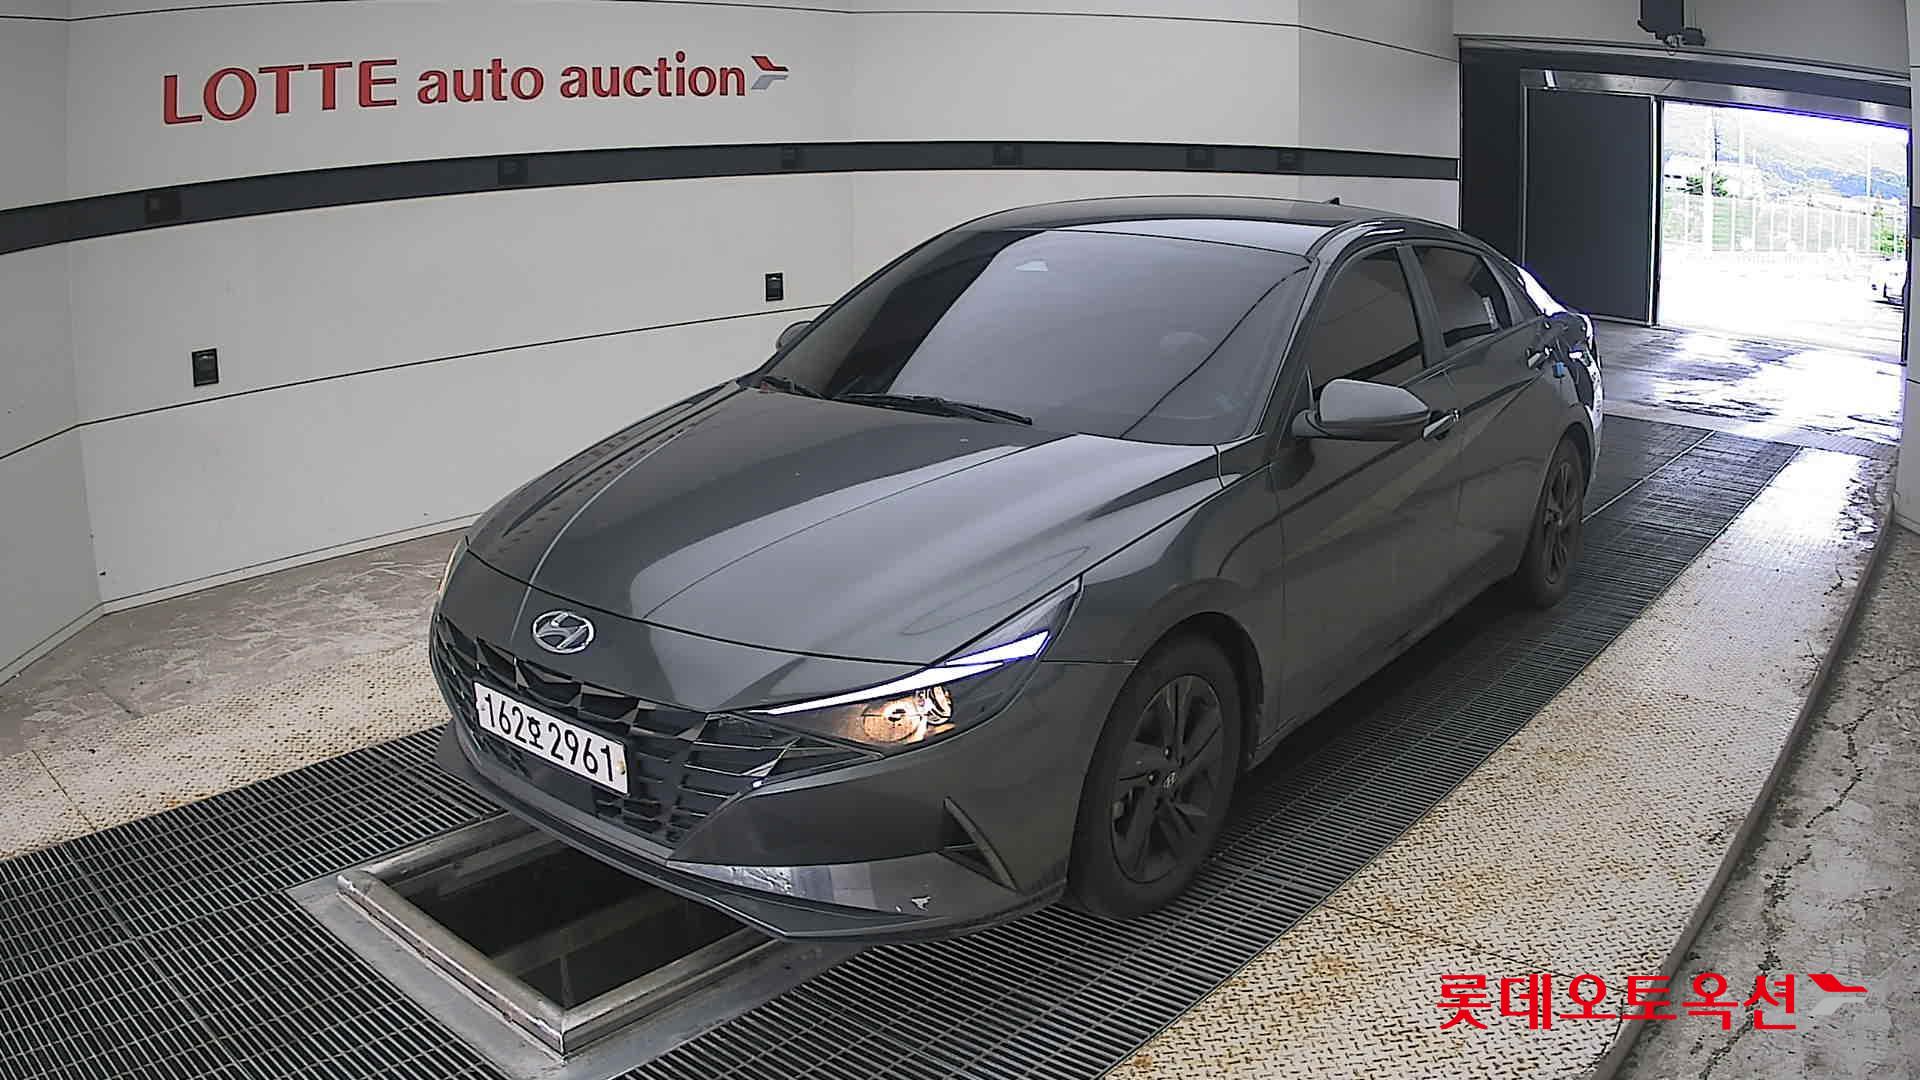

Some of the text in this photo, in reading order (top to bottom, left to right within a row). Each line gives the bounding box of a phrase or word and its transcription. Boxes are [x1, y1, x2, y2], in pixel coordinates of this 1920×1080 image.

[163, 51, 746, 125] LOTTE auto auction
